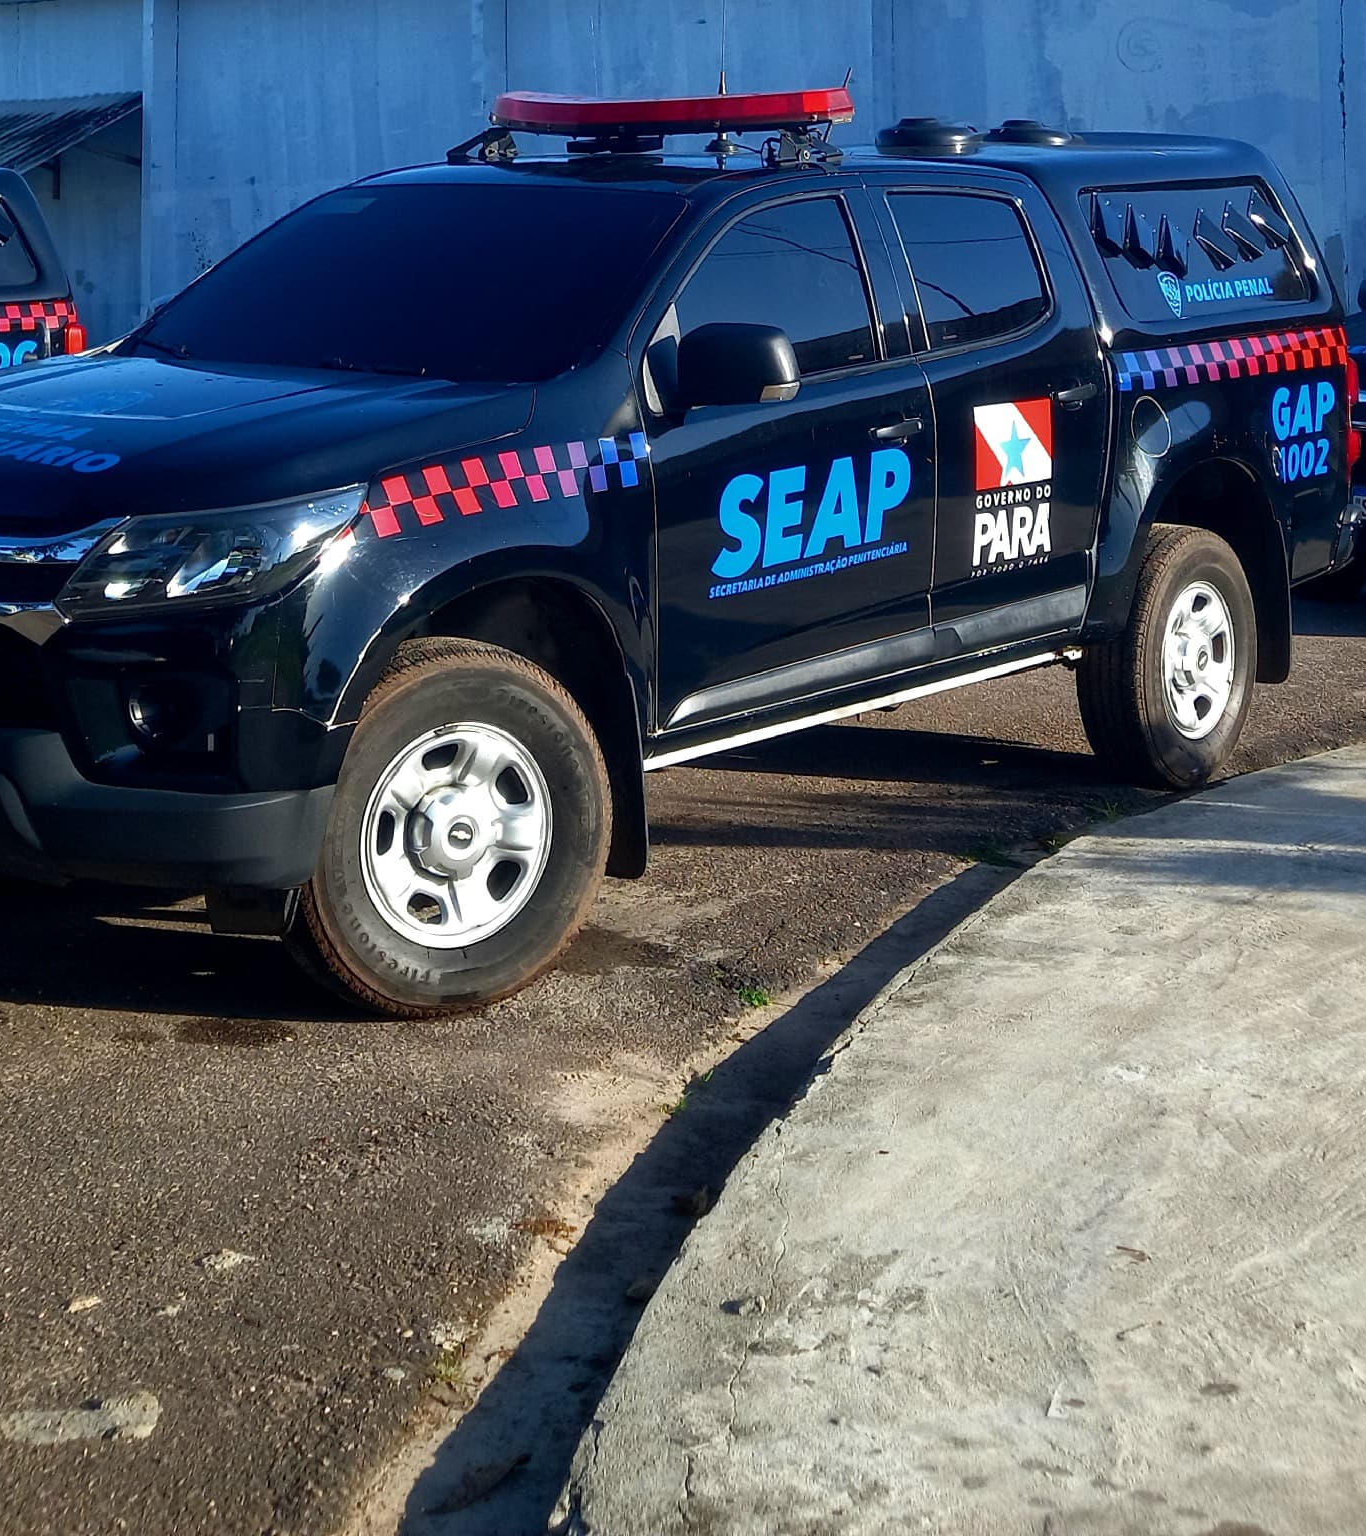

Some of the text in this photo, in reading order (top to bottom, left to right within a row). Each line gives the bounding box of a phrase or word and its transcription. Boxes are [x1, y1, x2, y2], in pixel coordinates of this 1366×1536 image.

[1185, 277, 1274, 302] POLÍCIA PENAL
[1272, 381, 1335, 441] GAP
[711, 448, 911, 579] SEAP
[976, 484, 1051, 509] GOVERNO DO
[708, 541, 908, 599] SECRETARIA DE ADMINISTRAÇÃO PENITENCIÁRIA
[341, 904, 431, 985] Firestone
